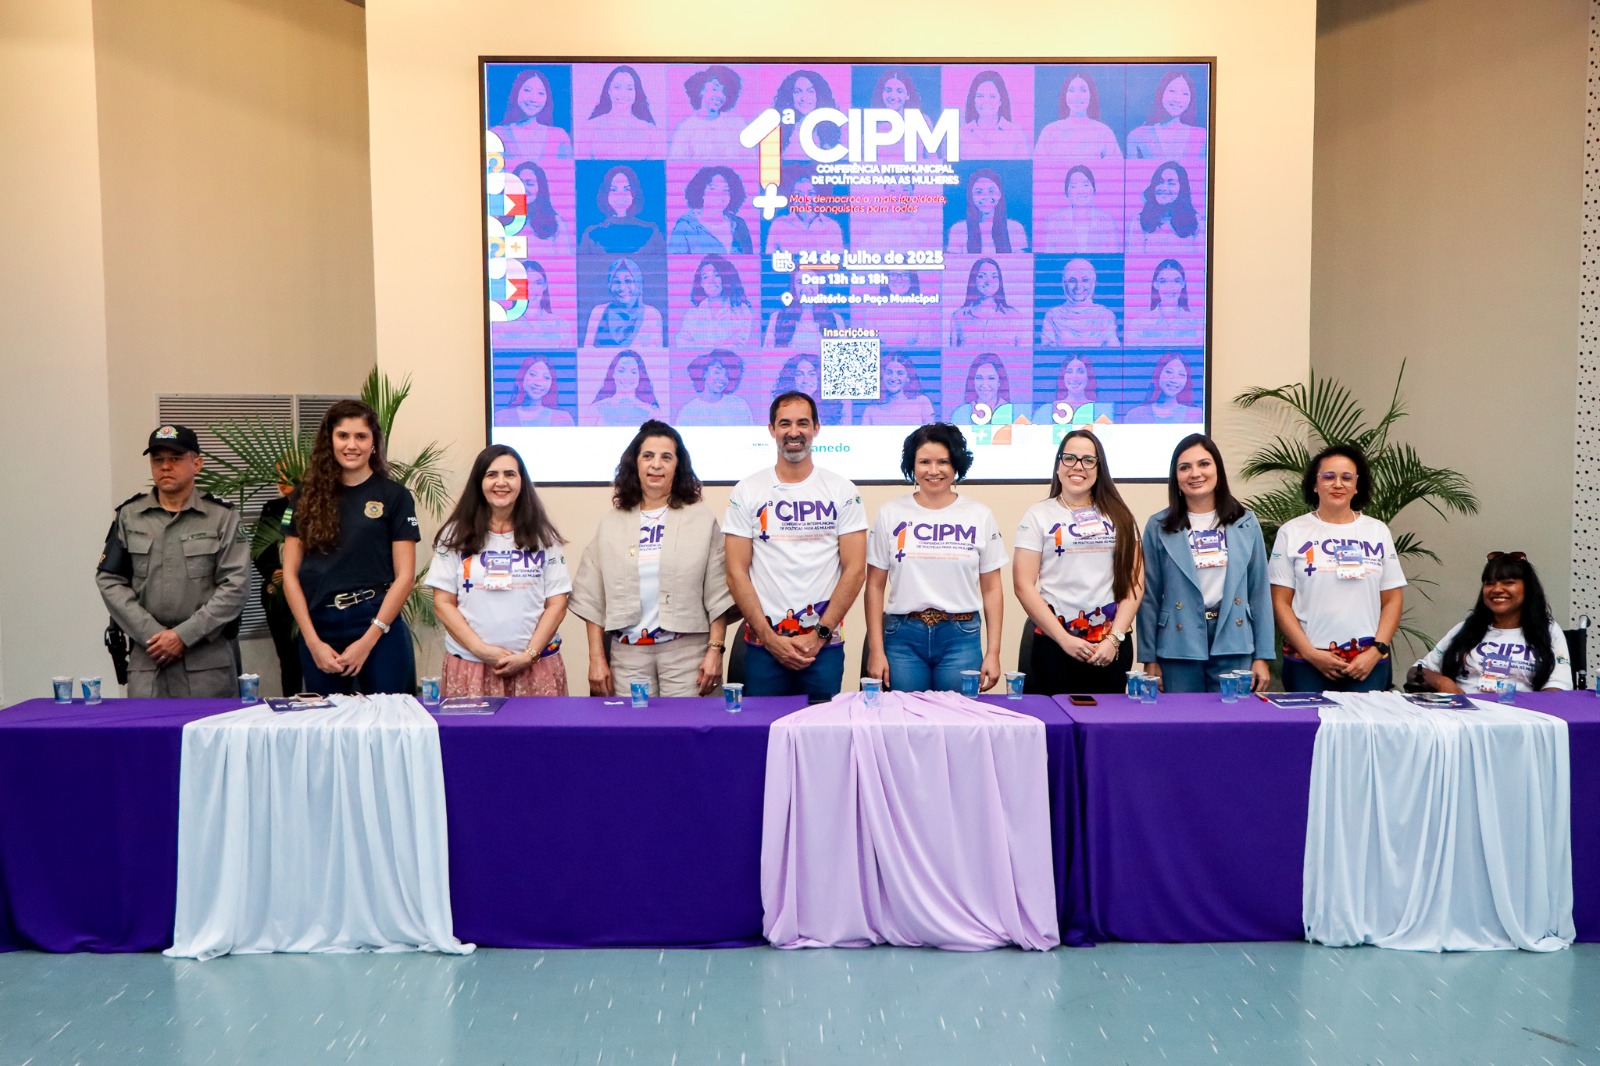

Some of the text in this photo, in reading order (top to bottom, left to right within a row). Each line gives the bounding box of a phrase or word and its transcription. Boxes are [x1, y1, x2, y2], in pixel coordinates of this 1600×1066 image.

[799, 107, 960, 163] CIPM
[816, 163, 955, 174] CONFERÊNCIA INTERMUNICIPAL
[811, 174, 960, 185] DE POLÍTICAS PARA AS MULHERES
[789, 194, 947, 206] Mais democracia, mais igualdade,
[789, 205, 812, 213] mais
[813, 204, 865, 214] conquistas
[866, 205, 890, 214] para
[799, 249, 944, 268] 24 de julho de 2025
[801, 273, 889, 285] Das 13h às 18h
[799, 293, 939, 306] Auditório do Paço Municipal
[823, 328, 879, 338] Inscrições:
[811, 443, 851, 453] anedo
[775, 500, 838, 522] CIPM
[913, 522, 977, 545] CIPM
